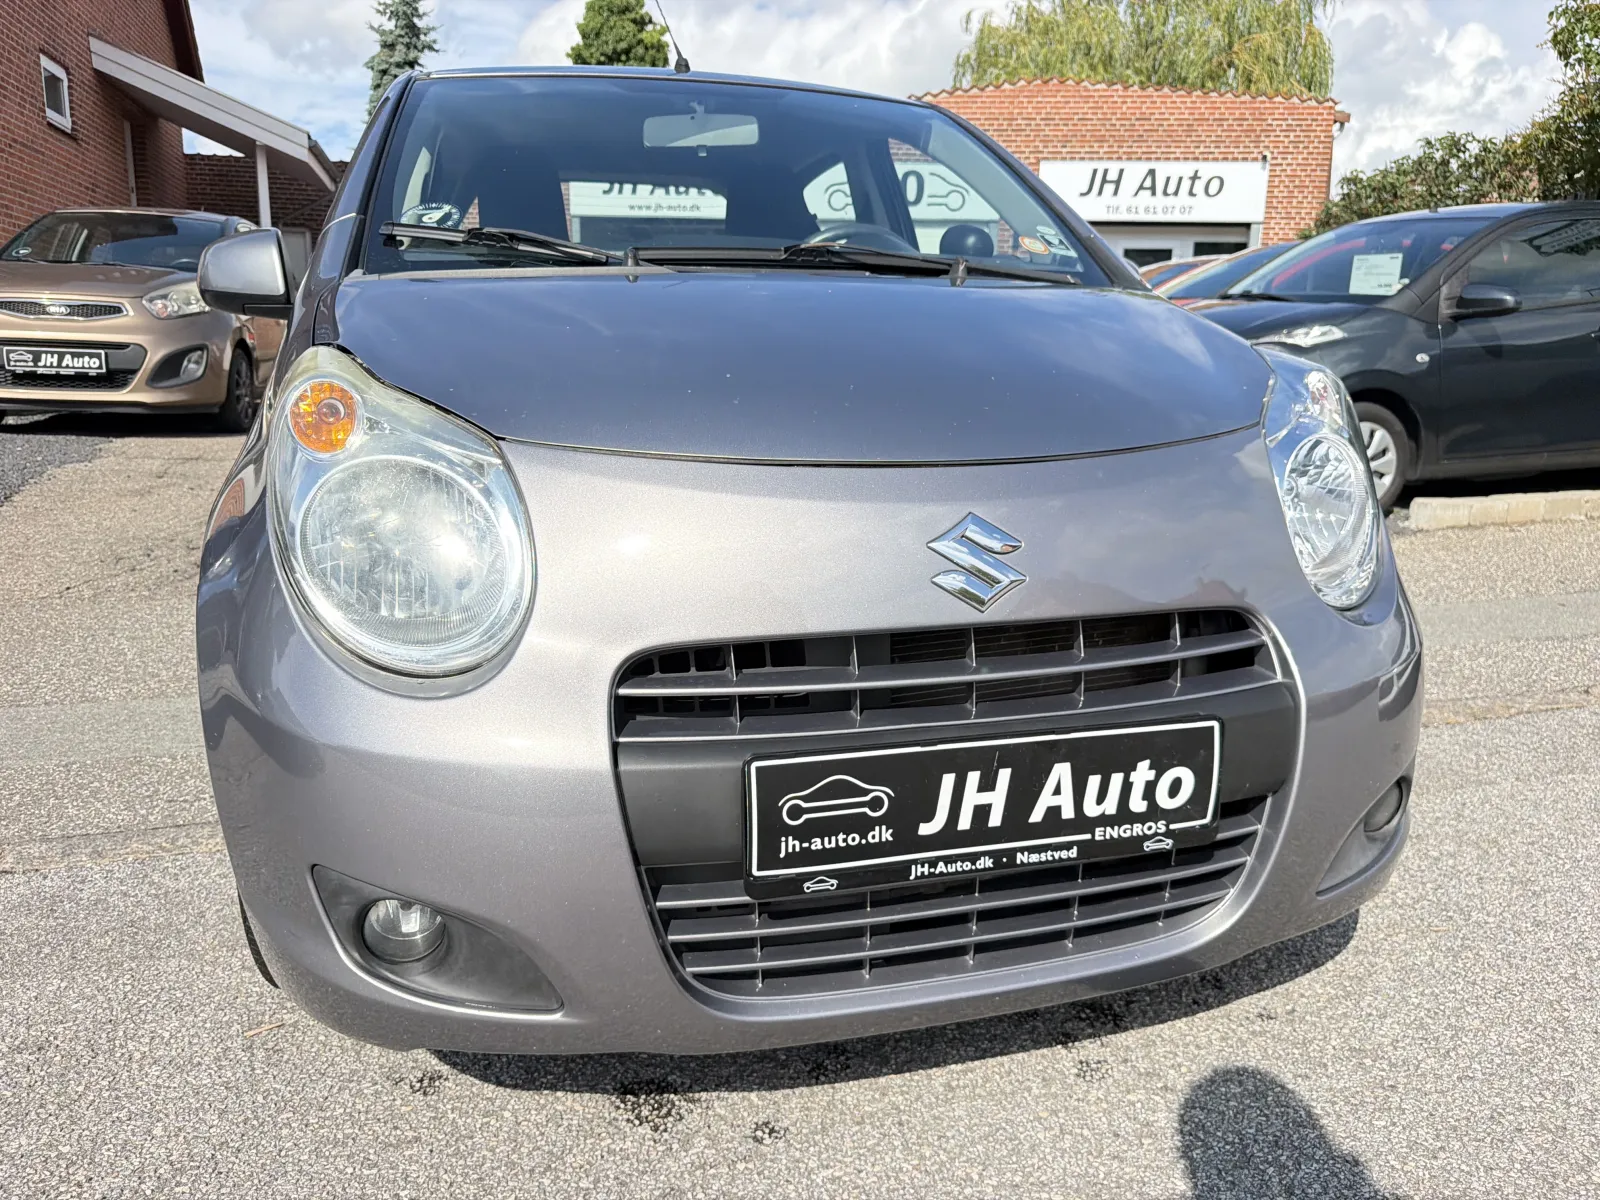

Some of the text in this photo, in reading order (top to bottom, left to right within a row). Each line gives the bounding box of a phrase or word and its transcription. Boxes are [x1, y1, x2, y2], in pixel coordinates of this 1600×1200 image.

[1079, 167, 1225, 198] JH Auto
[628, 204, 701, 213] www.jh-auto.dk
[1126, 204, 1140, 215] 61
[1144, 204, 1158, 215] 61
[1162, 204, 1176, 215] 07
[1179, 204, 1193, 215] 07
[50, 305, 66, 314] KIA
[37, 353, 58, 367] JH
[61, 354, 100, 368] Auto
[918, 759, 1195, 836] JH Auto
[779, 825, 894, 858] jh-auto.dk
[1093, 820, 1168, 842] ENGROS
[909, 846, 1078, 880] JH-Auto.dk Næstved
